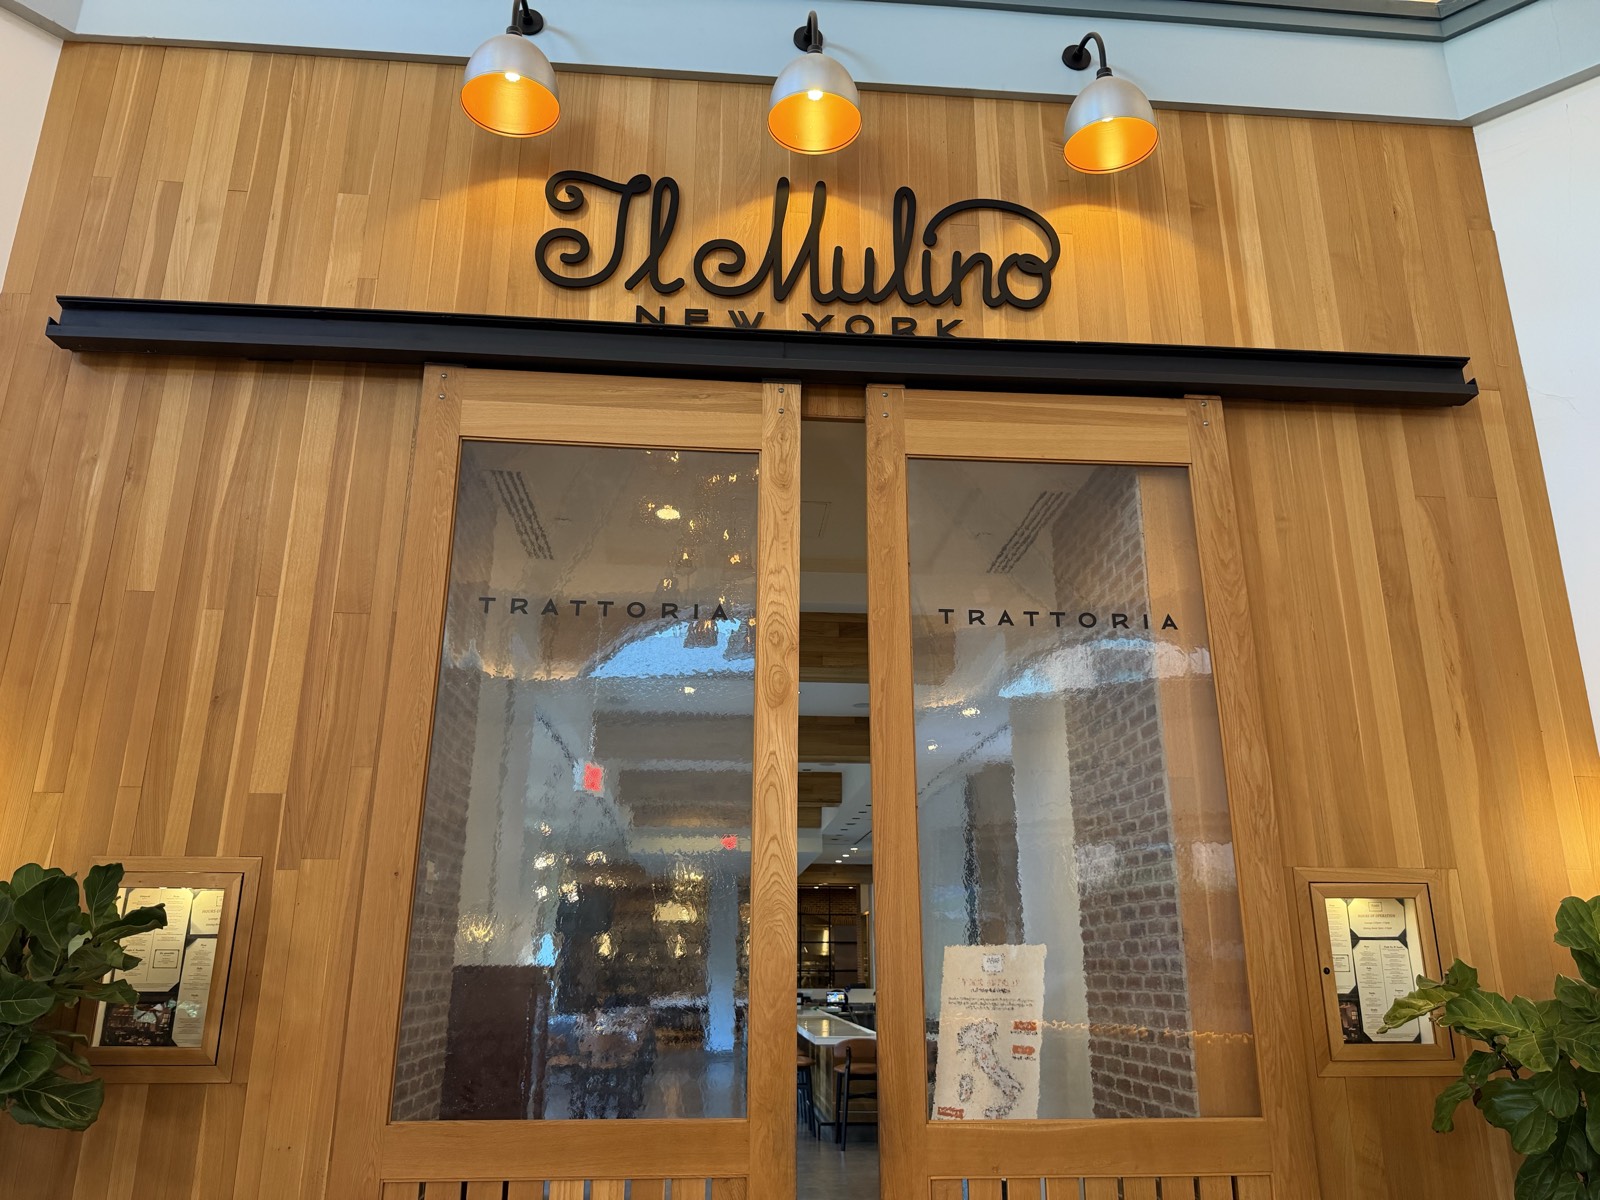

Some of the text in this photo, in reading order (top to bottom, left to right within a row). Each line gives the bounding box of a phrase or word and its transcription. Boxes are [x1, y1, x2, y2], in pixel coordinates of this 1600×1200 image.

[535, 170, 1061, 309] Il Mulino
[635, 305, 964, 338] NEW YORK
[478, 596, 729, 620] TRATTORIA
[938, 608, 1179, 630] TRATTORIA
